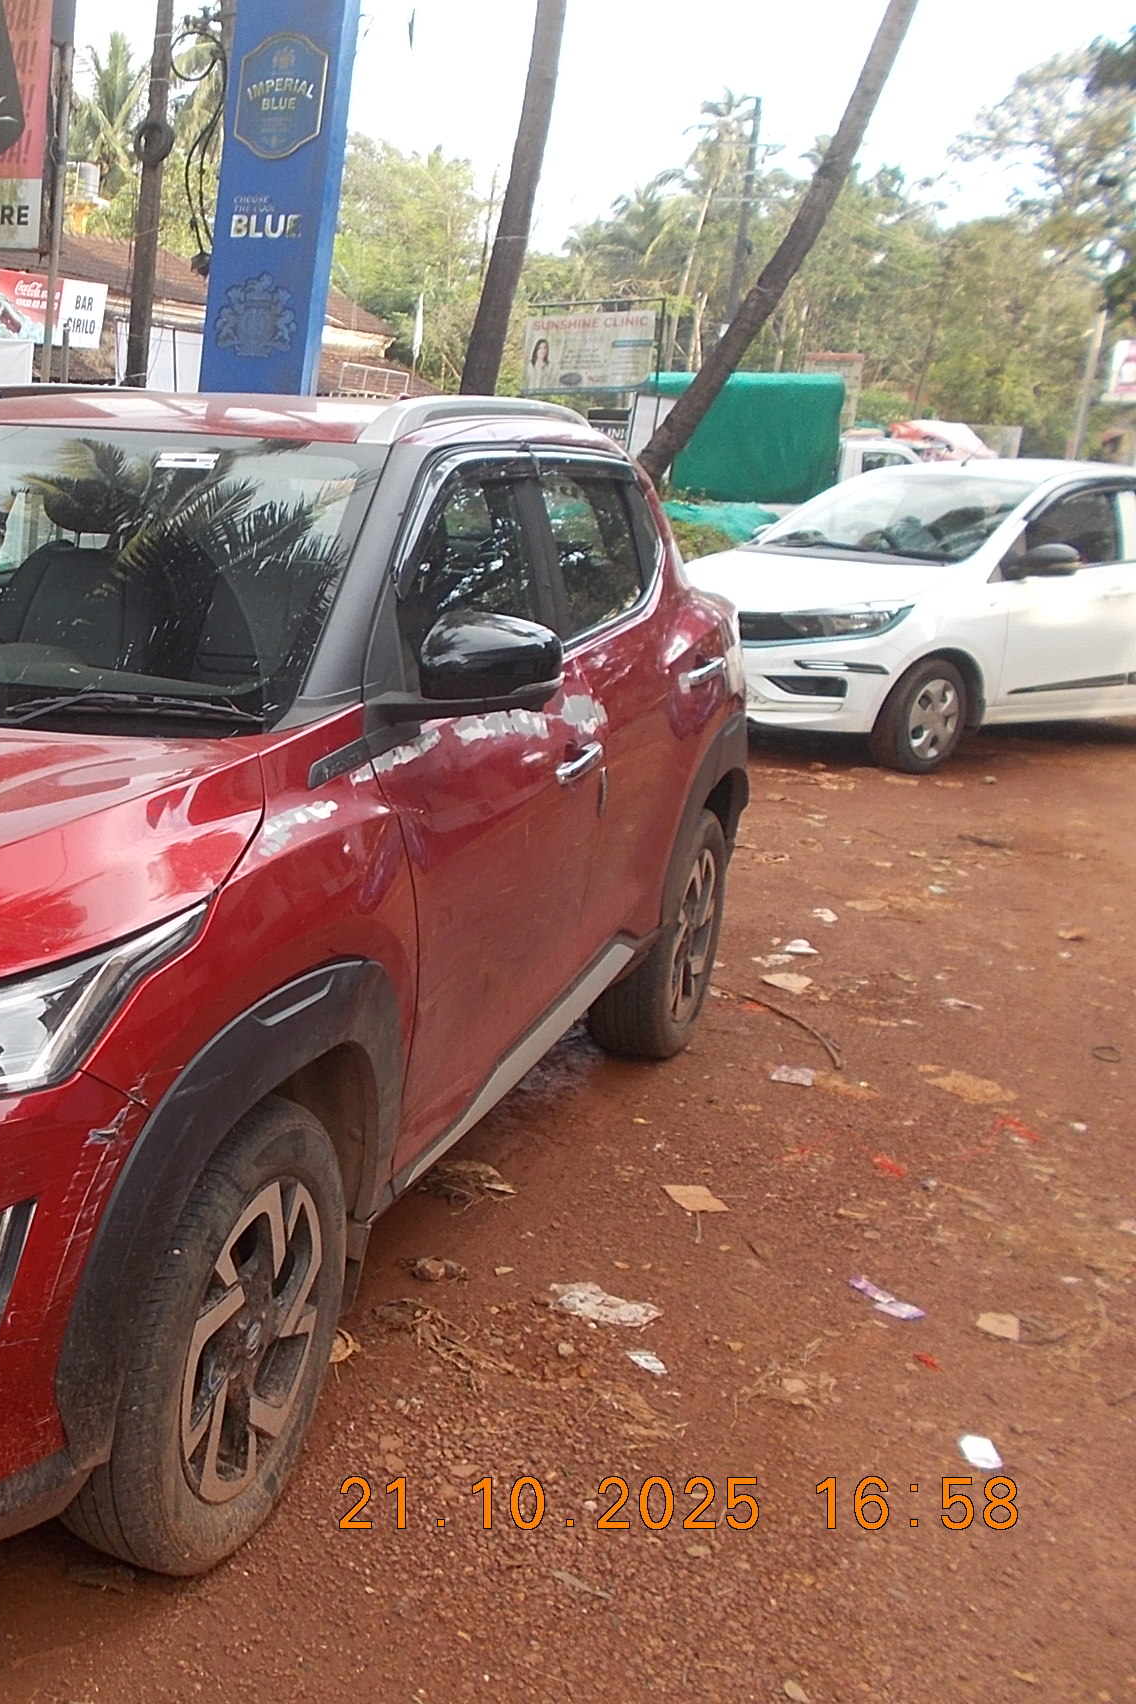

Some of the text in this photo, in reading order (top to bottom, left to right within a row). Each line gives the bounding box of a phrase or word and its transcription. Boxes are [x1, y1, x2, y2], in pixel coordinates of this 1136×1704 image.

[247, 78, 314, 100] IMPERIAL
[261, 97, 297, 110] BLUE
[230, 214, 302, 239] BLUE
[75, 295, 94, 312] BAR
[533, 316, 649, 331] SUNSHINE CLINIC
